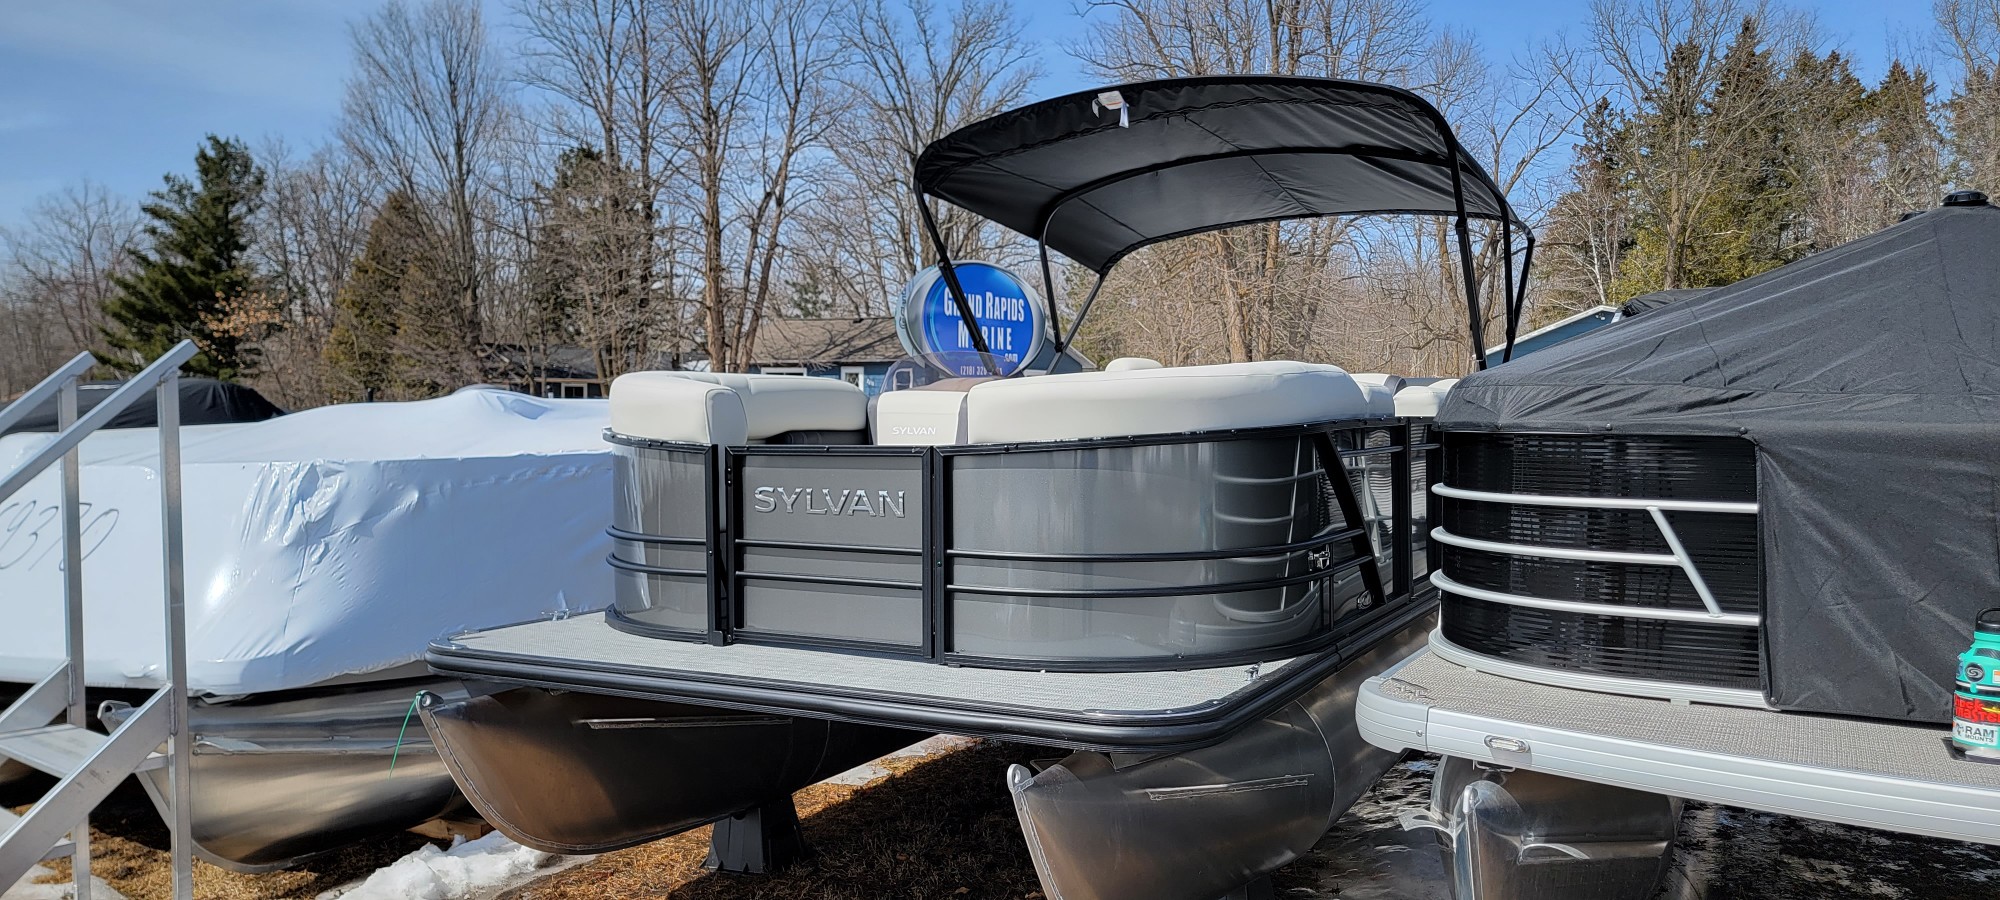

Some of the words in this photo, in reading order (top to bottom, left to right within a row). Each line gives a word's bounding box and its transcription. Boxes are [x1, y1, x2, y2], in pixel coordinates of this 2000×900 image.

[944, 287, 982, 318] GND
[985, 291, 1025, 322] RAPIDS
[957, 320, 1012, 350] MRINE
[892, 426, 937, 436] SYLVAN
[754, 486, 906, 518] SYLVAN
[1965, 726, 1994, 738] RAM
[1965, 733, 1994, 743] MOUNTS
